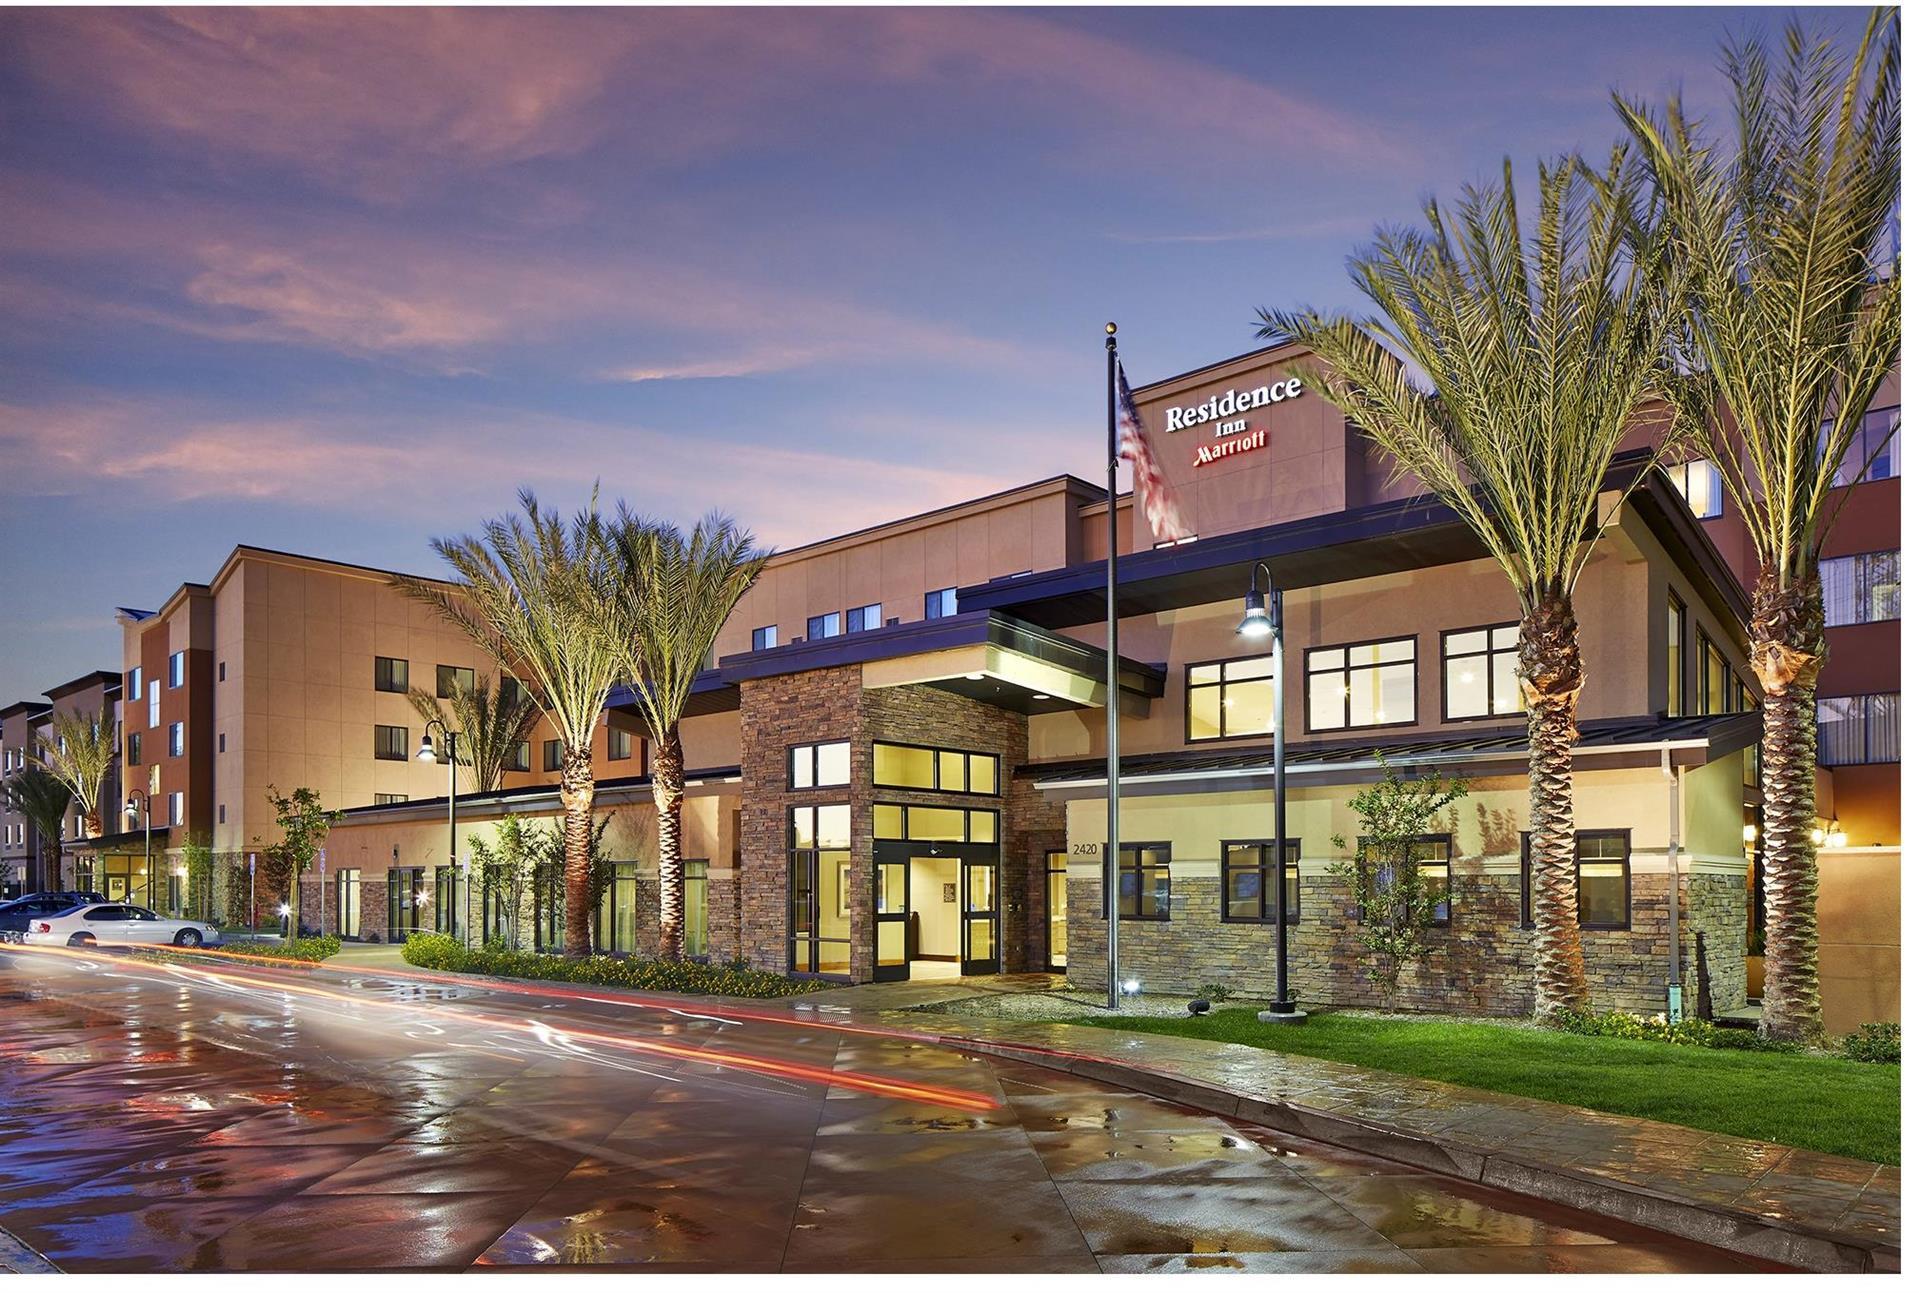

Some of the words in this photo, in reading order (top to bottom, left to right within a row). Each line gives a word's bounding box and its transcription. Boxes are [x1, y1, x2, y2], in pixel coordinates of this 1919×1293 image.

[1165, 377, 1302, 432] Residence
[1215, 418, 1247, 437] Inn
[1192, 430, 1265, 467] Marriott
[1073, 843, 1098, 855] 2420
